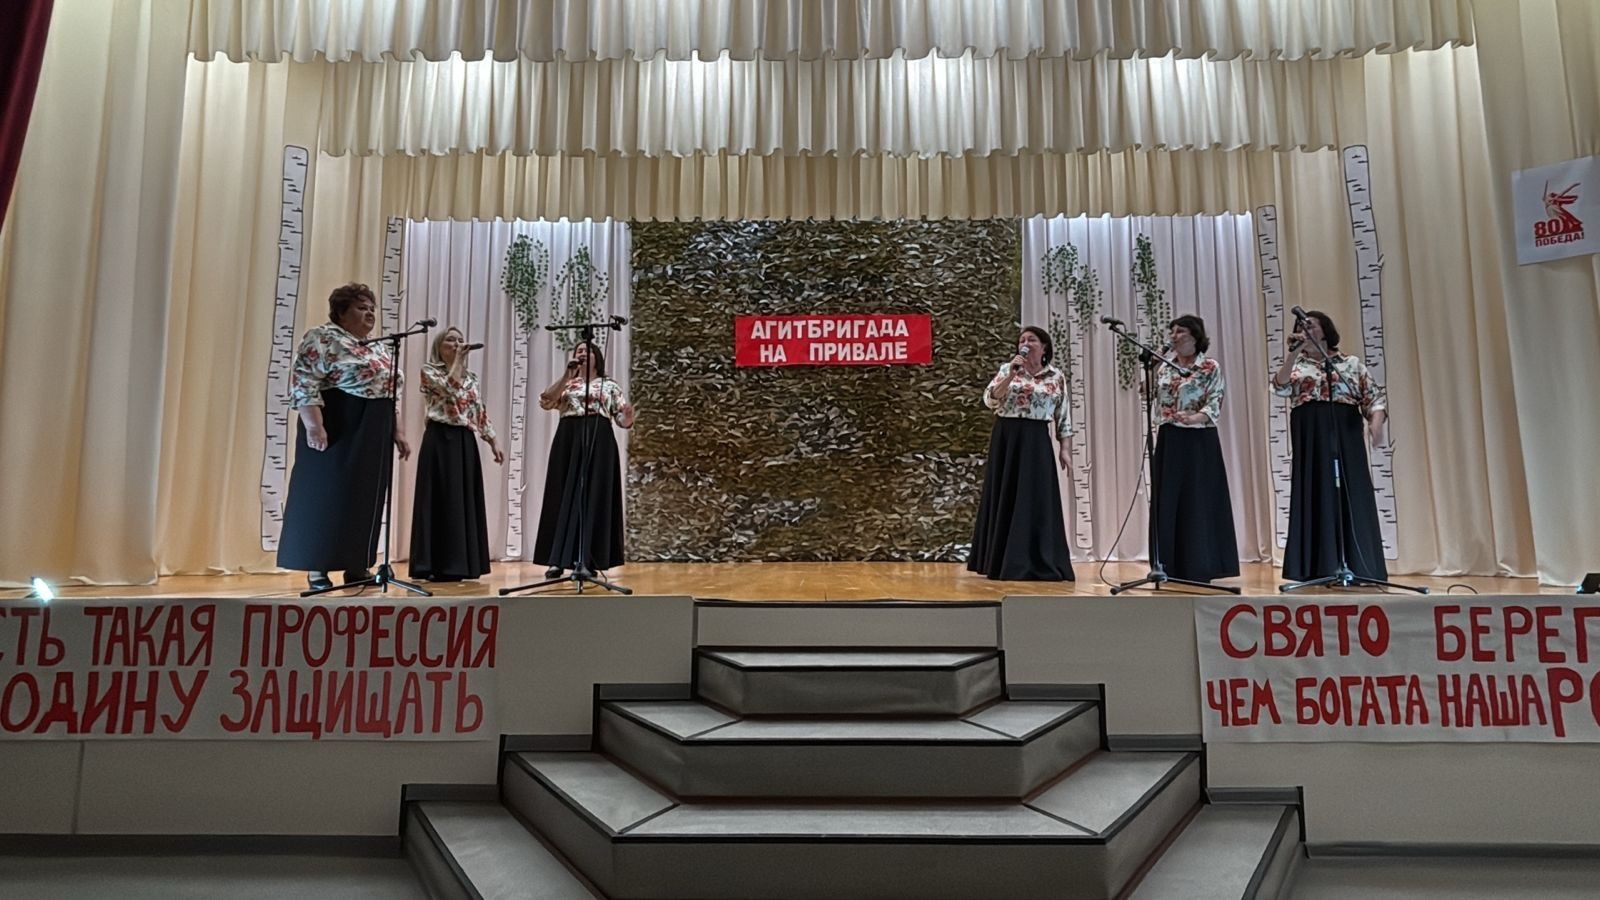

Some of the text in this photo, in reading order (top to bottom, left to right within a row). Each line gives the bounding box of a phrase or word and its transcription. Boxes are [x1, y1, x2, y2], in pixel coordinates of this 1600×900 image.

[1535, 232, 1584, 247] ПОБЕДА!
[751, 319, 909, 339] АГИТБРИГАДА
[760, 341, 908, 363] НА ПРИВАЛЕ
[0, 604, 499, 668] ТЬ ТАКАЯ ПРОФЕССИЯ
[1220, 603, 1600, 663] СВЯТО БЕРЕГ
[0, 669, 484, 740] ОДИНУ ЗАЩИЩАТЬ
[1206, 678, 1282, 727] ЧЕМ
[1296, 674, 1430, 726] БОГАТА
[1437, 673, 1547, 727] НАША
